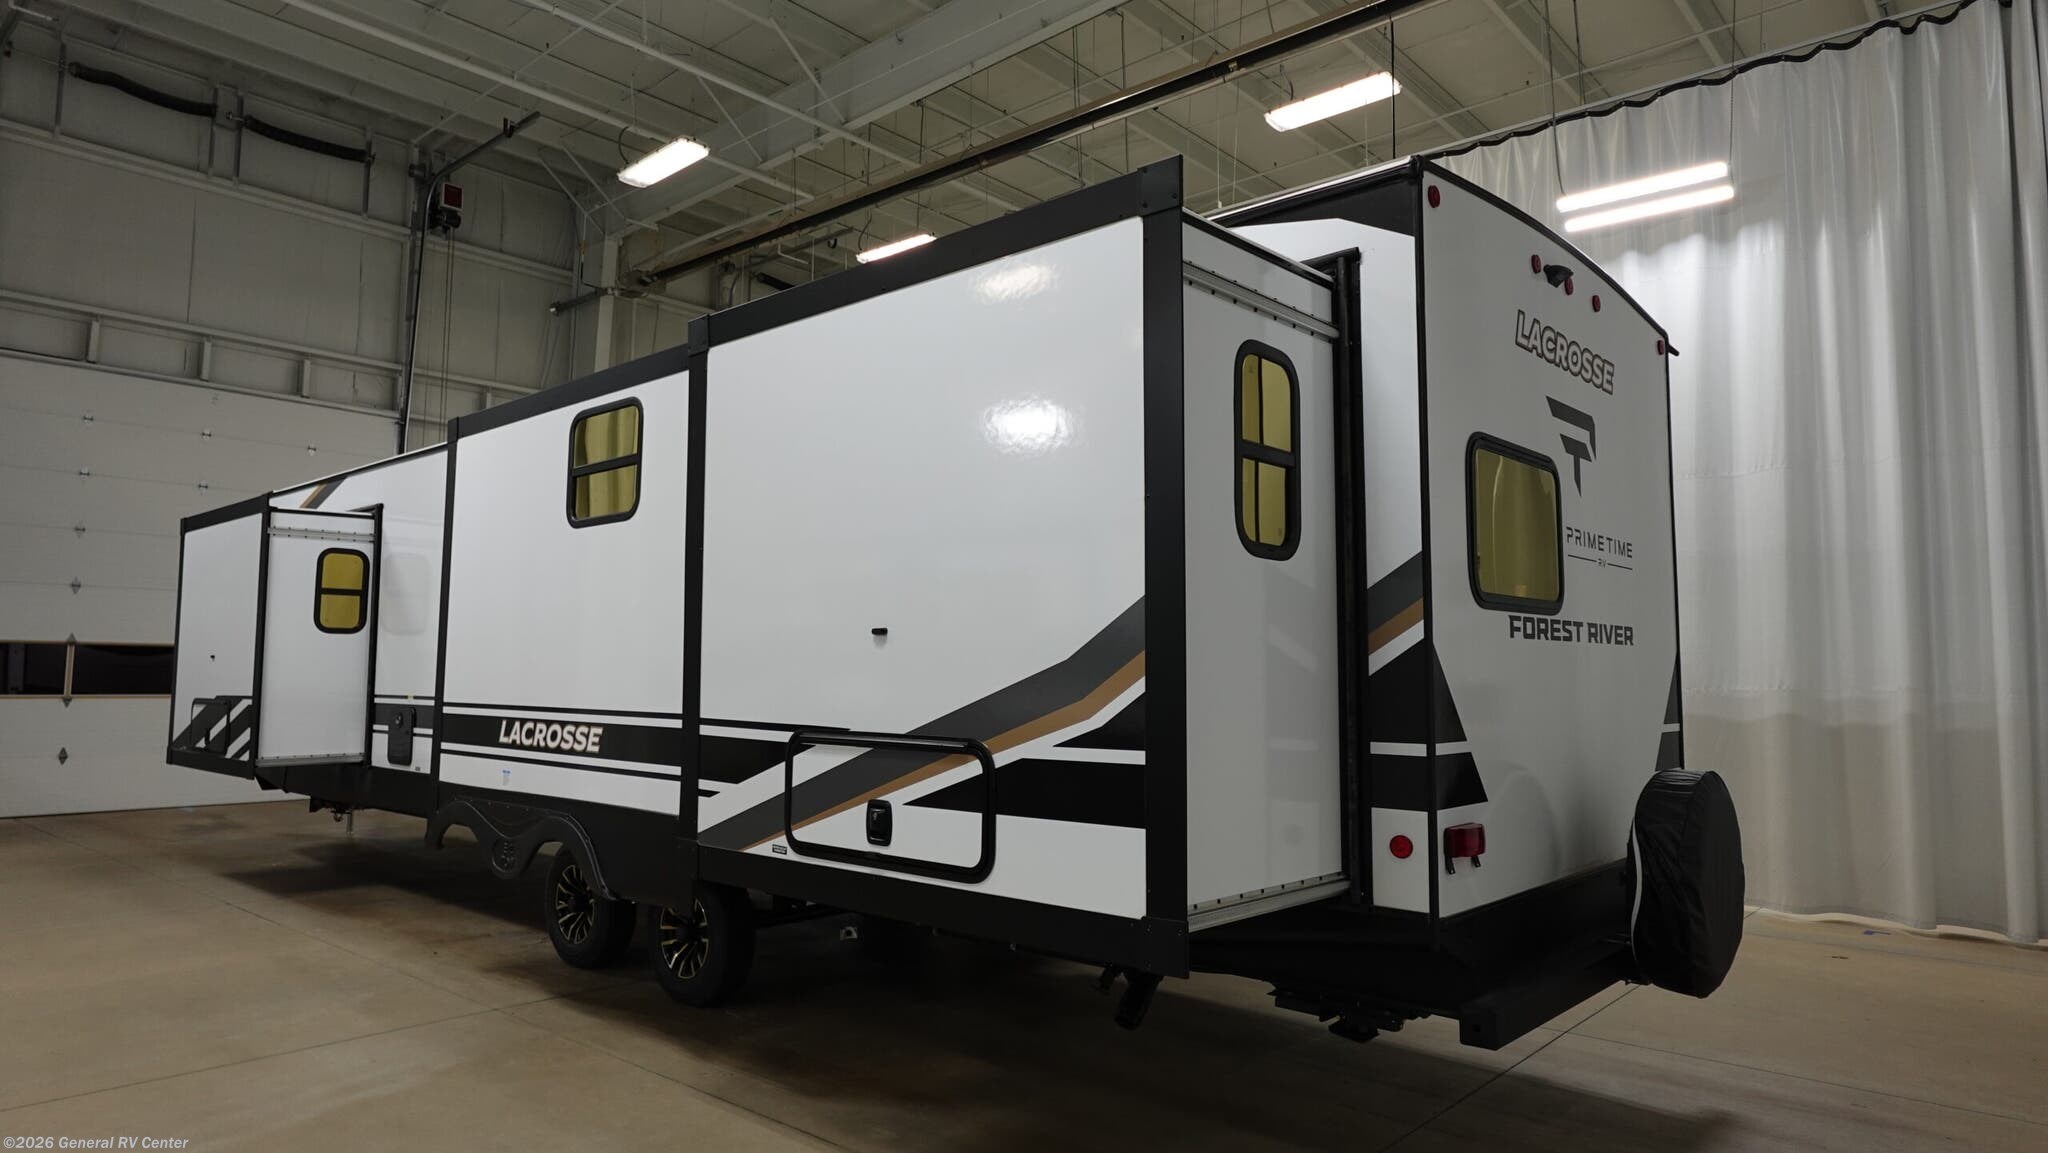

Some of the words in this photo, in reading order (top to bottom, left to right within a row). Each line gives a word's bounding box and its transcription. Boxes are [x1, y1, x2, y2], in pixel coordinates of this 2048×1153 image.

[1515, 309, 1615, 395] LACROSSE
[1566, 526, 1633, 559] PRIMETIME
[1508, 615, 1583, 642] FOREST
[1587, 622, 1634, 646] RIVER
[498, 719, 604, 754] LACROSSE
